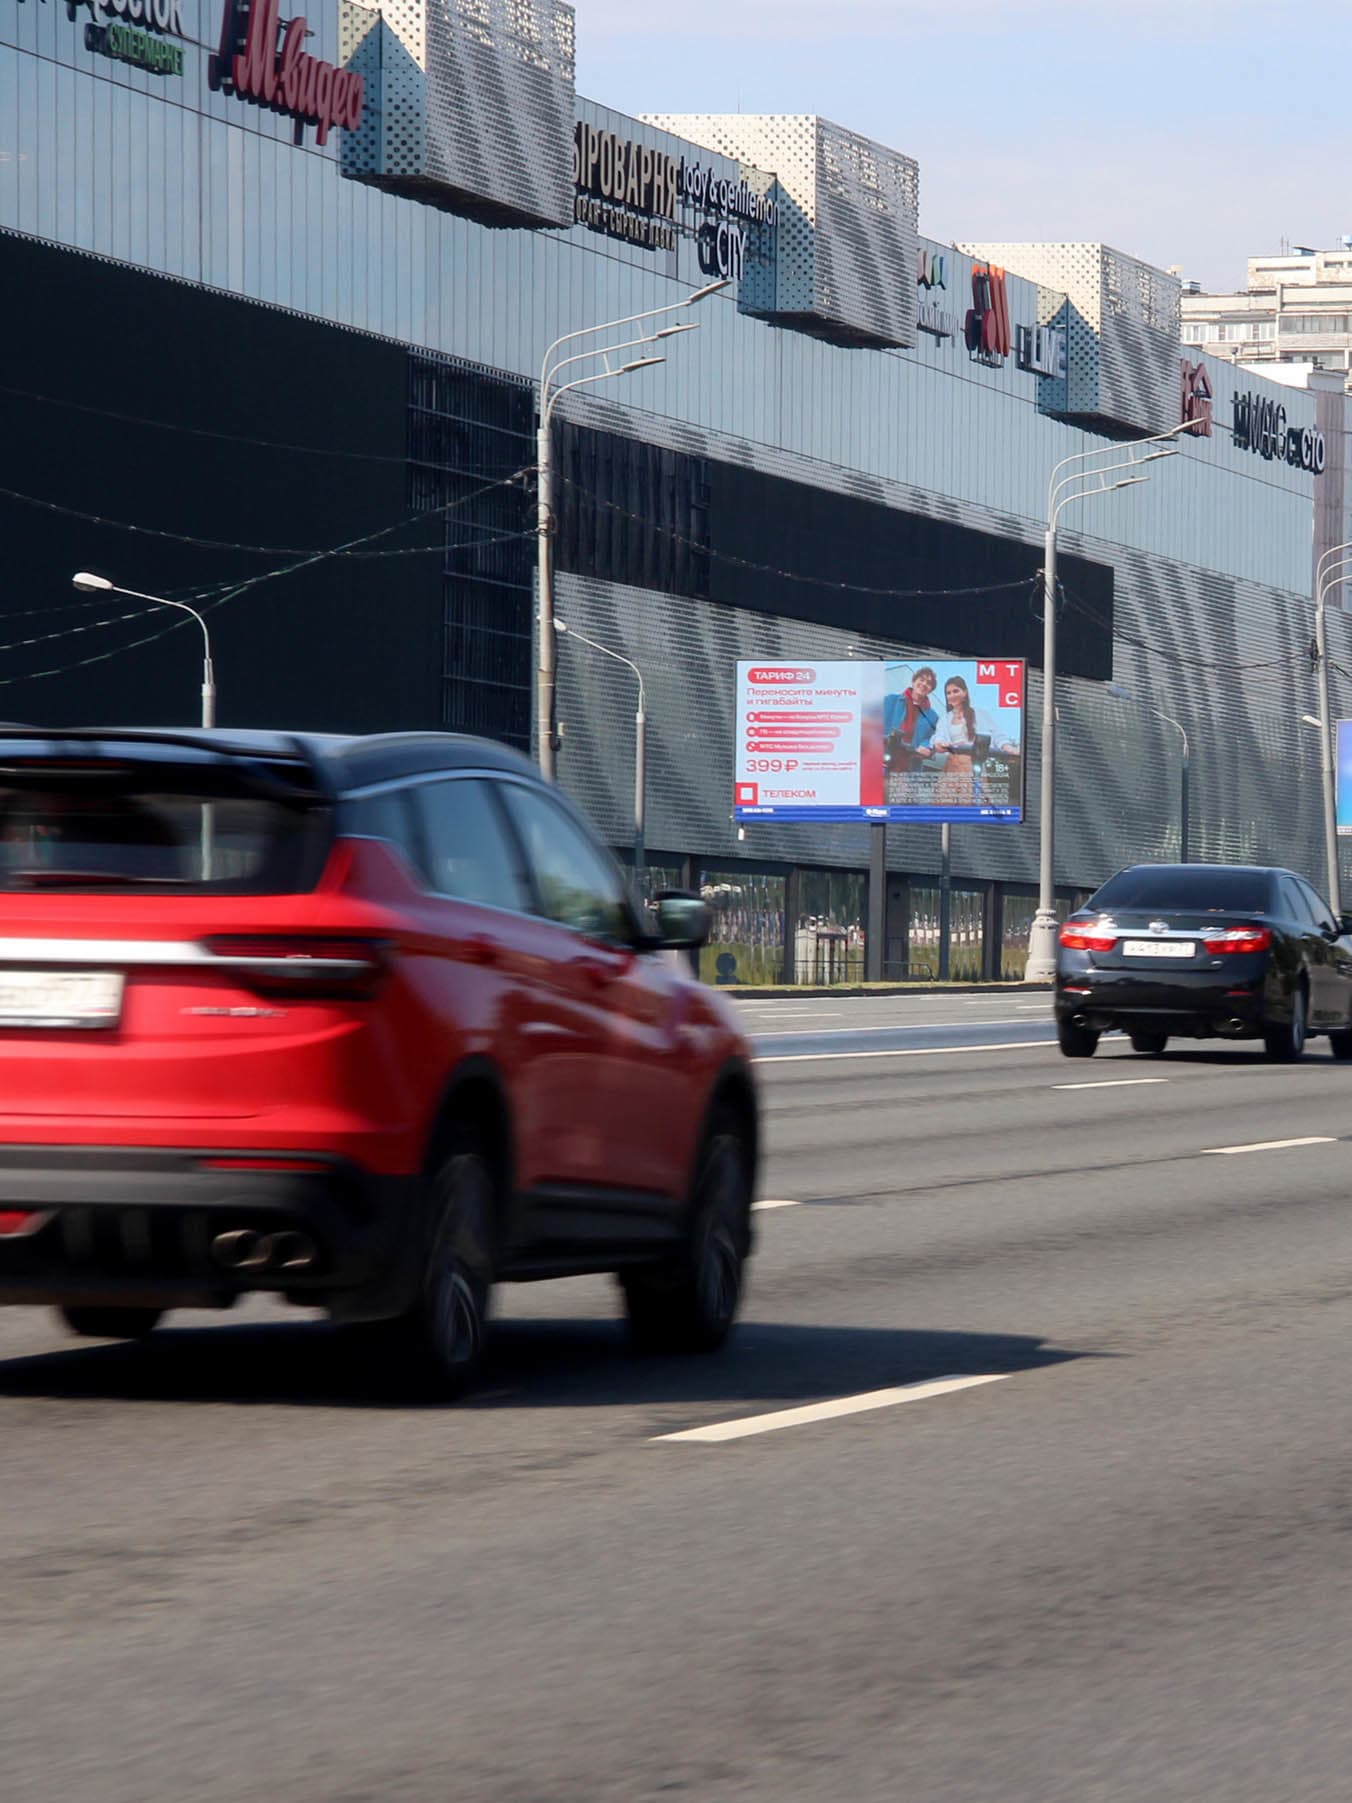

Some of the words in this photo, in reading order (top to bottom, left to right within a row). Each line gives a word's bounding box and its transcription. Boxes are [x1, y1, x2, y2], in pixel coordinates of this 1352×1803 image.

[717, 222, 746, 281] CITY
[754, 671, 795, 681] ТАРИФ
[796, 671, 811, 681] 24
[746, 687, 813, 697] Переносите
[815, 689, 857, 698] минуты
[755, 697, 814, 706] гигабайты
[746, 759, 783, 772] 399
[762, 789, 817, 798] ТЕЛЕКОМ
